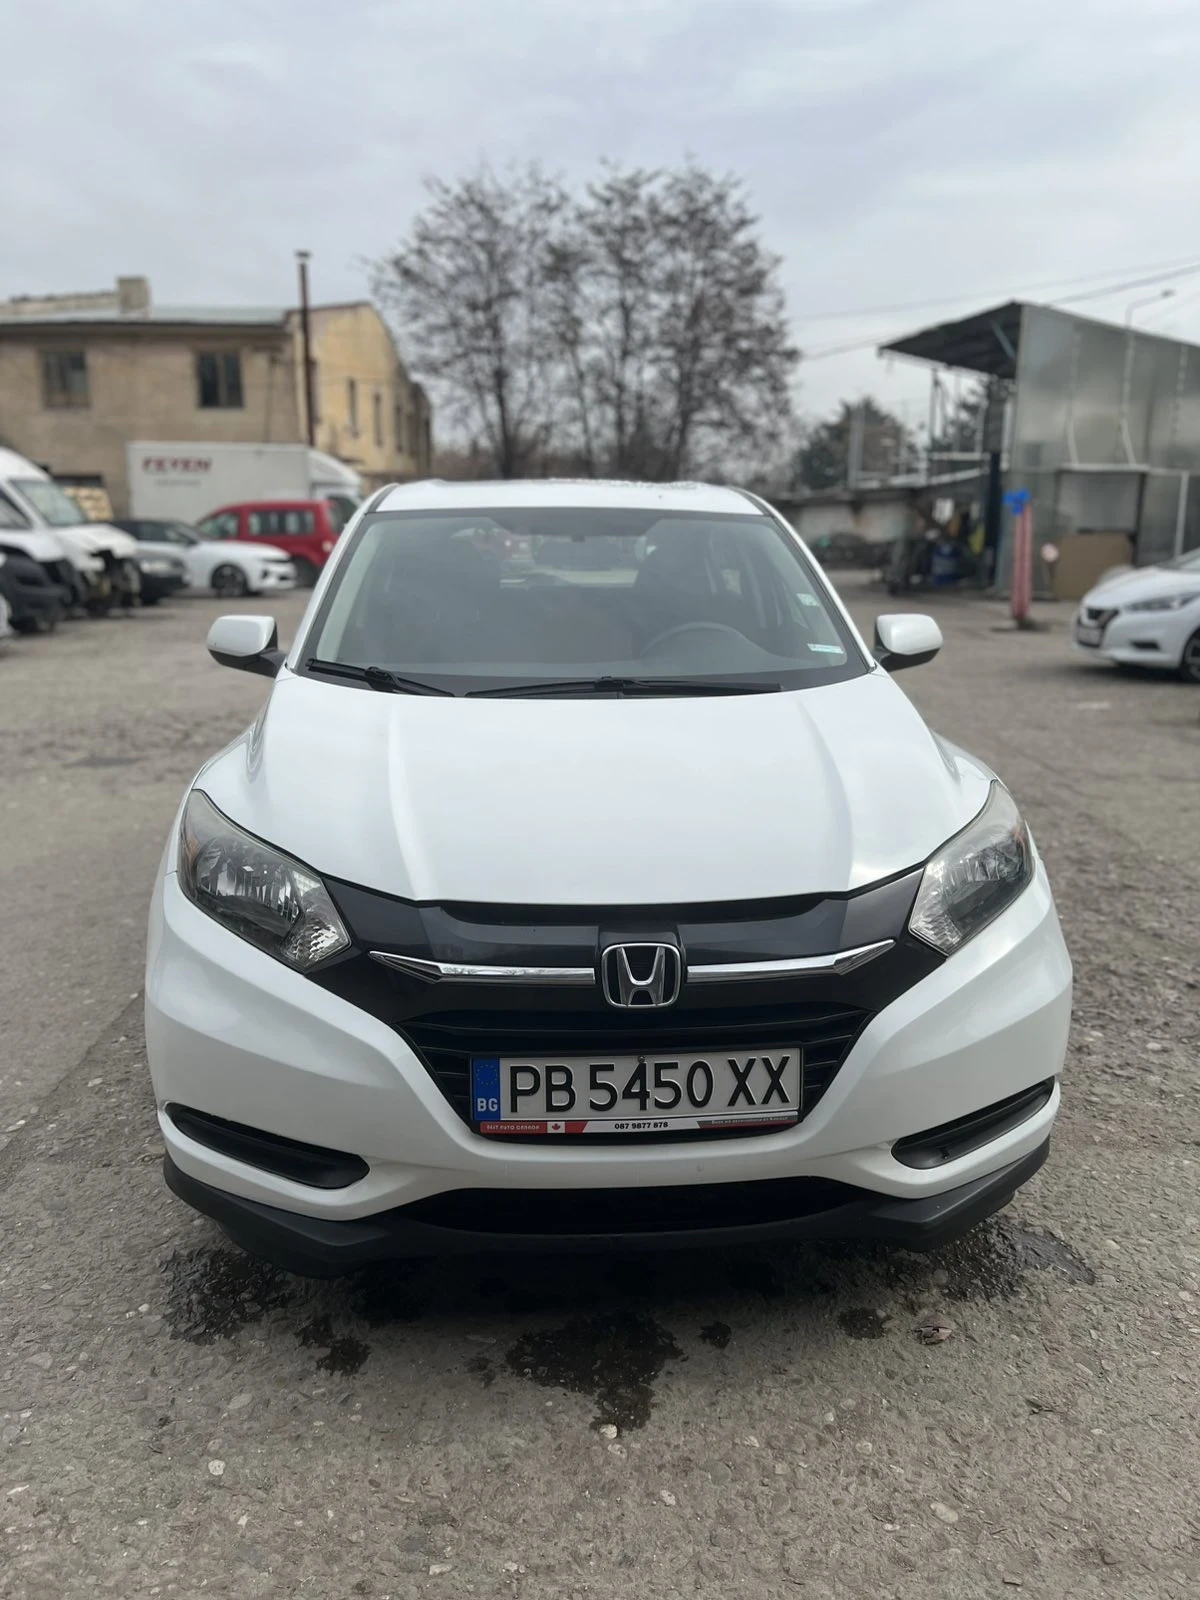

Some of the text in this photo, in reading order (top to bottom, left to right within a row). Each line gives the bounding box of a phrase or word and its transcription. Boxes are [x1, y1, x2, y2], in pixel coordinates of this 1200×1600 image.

[510, 1055, 791, 1113] PB 5450 XX
[477, 1097, 498, 1112] BG
